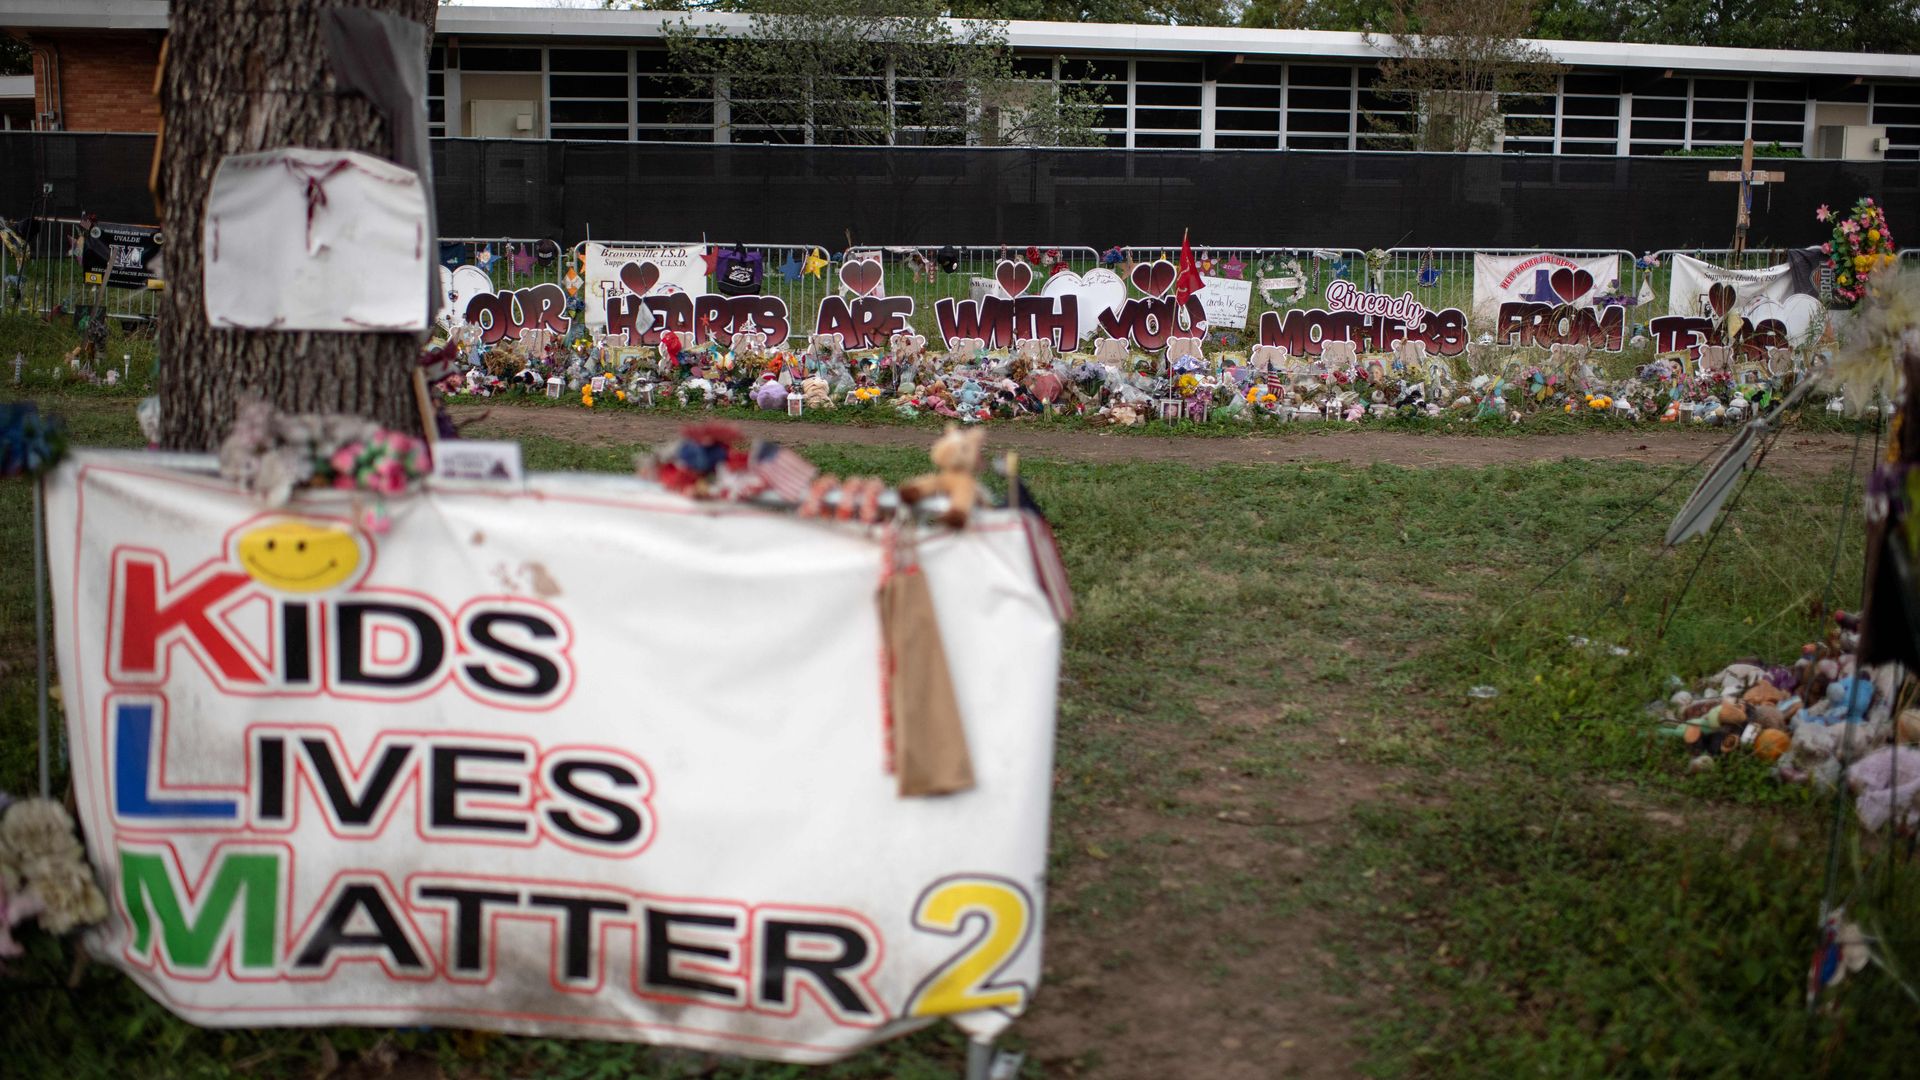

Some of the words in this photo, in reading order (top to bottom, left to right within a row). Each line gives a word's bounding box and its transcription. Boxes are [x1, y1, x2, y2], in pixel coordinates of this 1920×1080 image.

[114, 235, 140, 243] UVALDE
[600, 248, 659, 258] Brownsville
[660, 248, 688, 258] I.S.D.
[604, 259, 626, 268] Suppo
[660, 259, 687, 268] C.I.S.D.
[466, 284, 571, 345] OUR
[607, 292, 790, 348] HEARTS
[816, 296, 914, 351] ARE
[935, 295, 1080, 353] WITH
[1098, 296, 1209, 353] YOU
[1260, 309, 1470, 356] MOTHERS
[1497, 302, 1626, 353] FROM
[1327, 280, 1425, 329] Sincerely
[117, 558, 563, 700] KIDS
[114, 703, 644, 845] LIVES
[119, 850, 875, 1017] MATTER
[908, 876, 1031, 1018] 2
